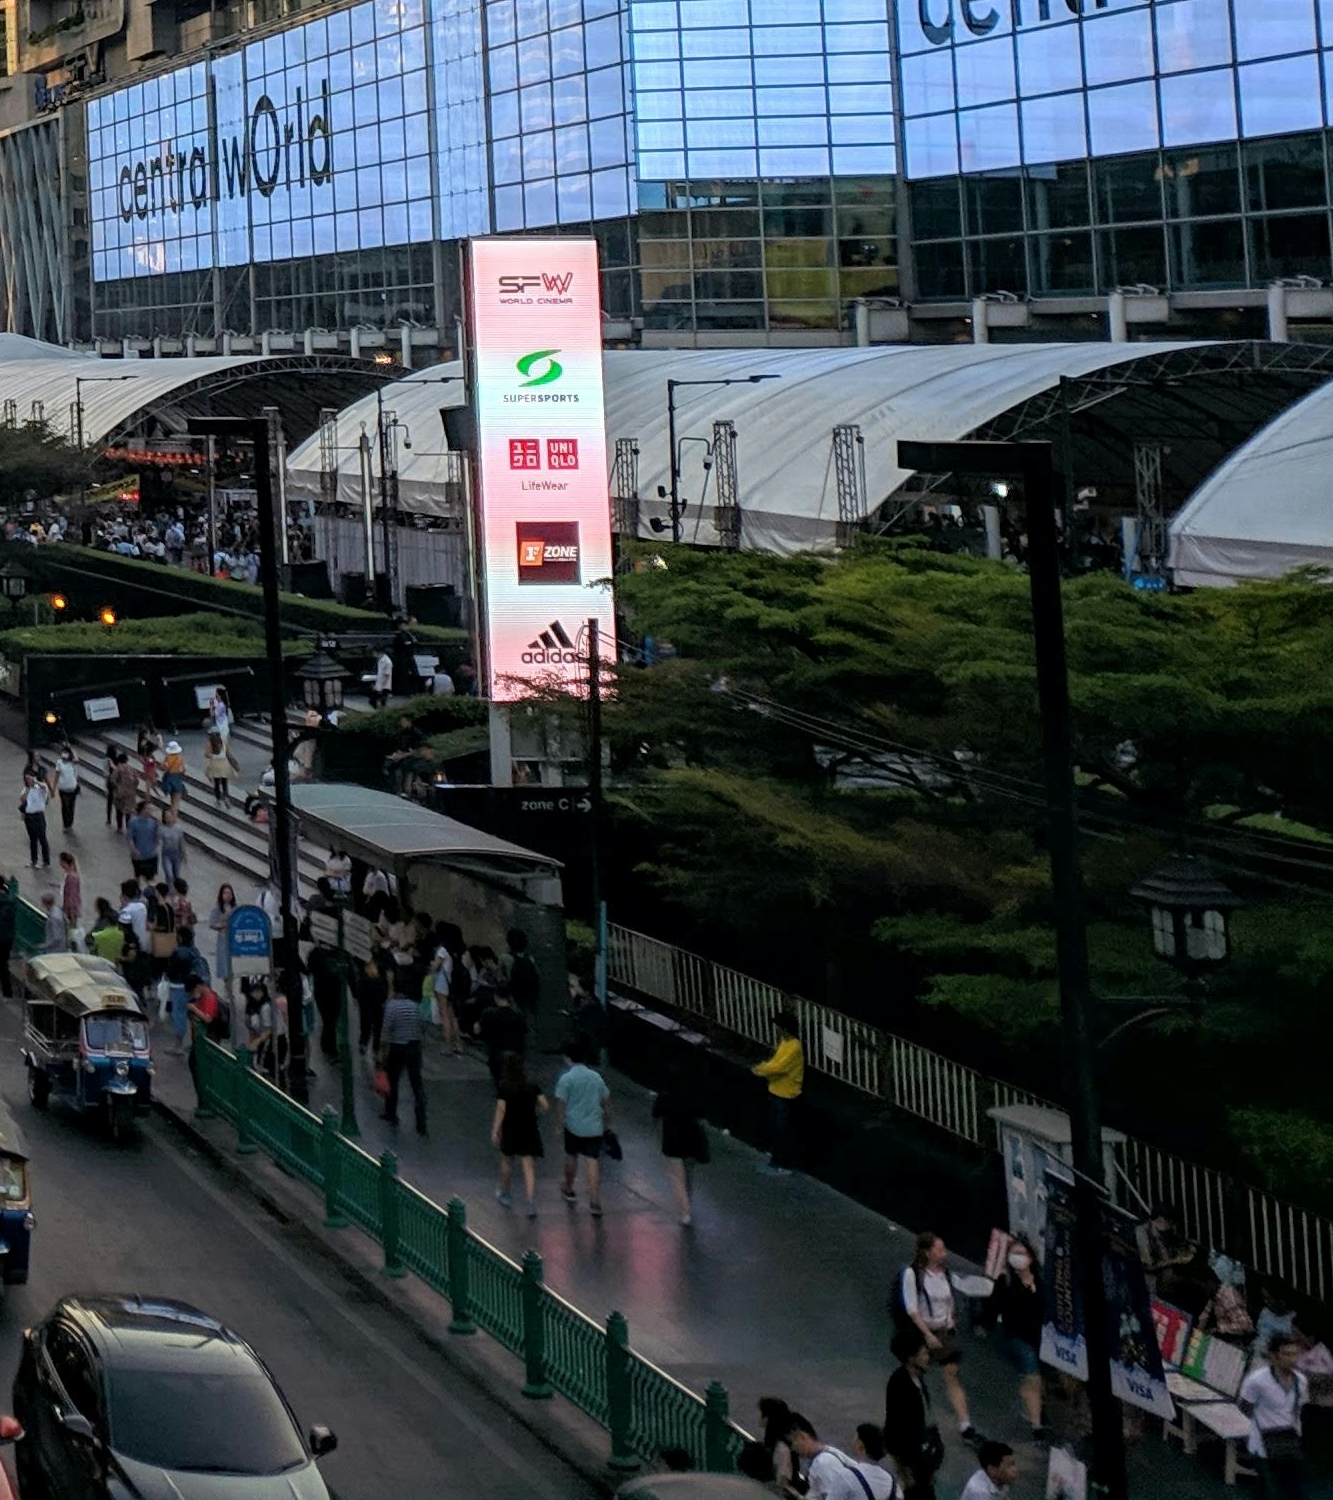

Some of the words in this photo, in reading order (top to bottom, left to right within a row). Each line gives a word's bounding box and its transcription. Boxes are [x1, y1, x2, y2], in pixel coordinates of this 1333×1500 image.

[503, 394, 580, 403] SUPERSPORTS
[549, 442, 573, 454] UNI
[550, 455, 576, 468] QLO
[522, 480, 568, 491] LifeWear
[543, 546, 579, 558] ZONE
[521, 649, 584, 665] adidas
[521, 799, 555, 811] zone
[558, 798, 570, 811] C
[1054, 1343, 1078, 1366] VISA
[1126, 1377, 1155, 1401] VISA
